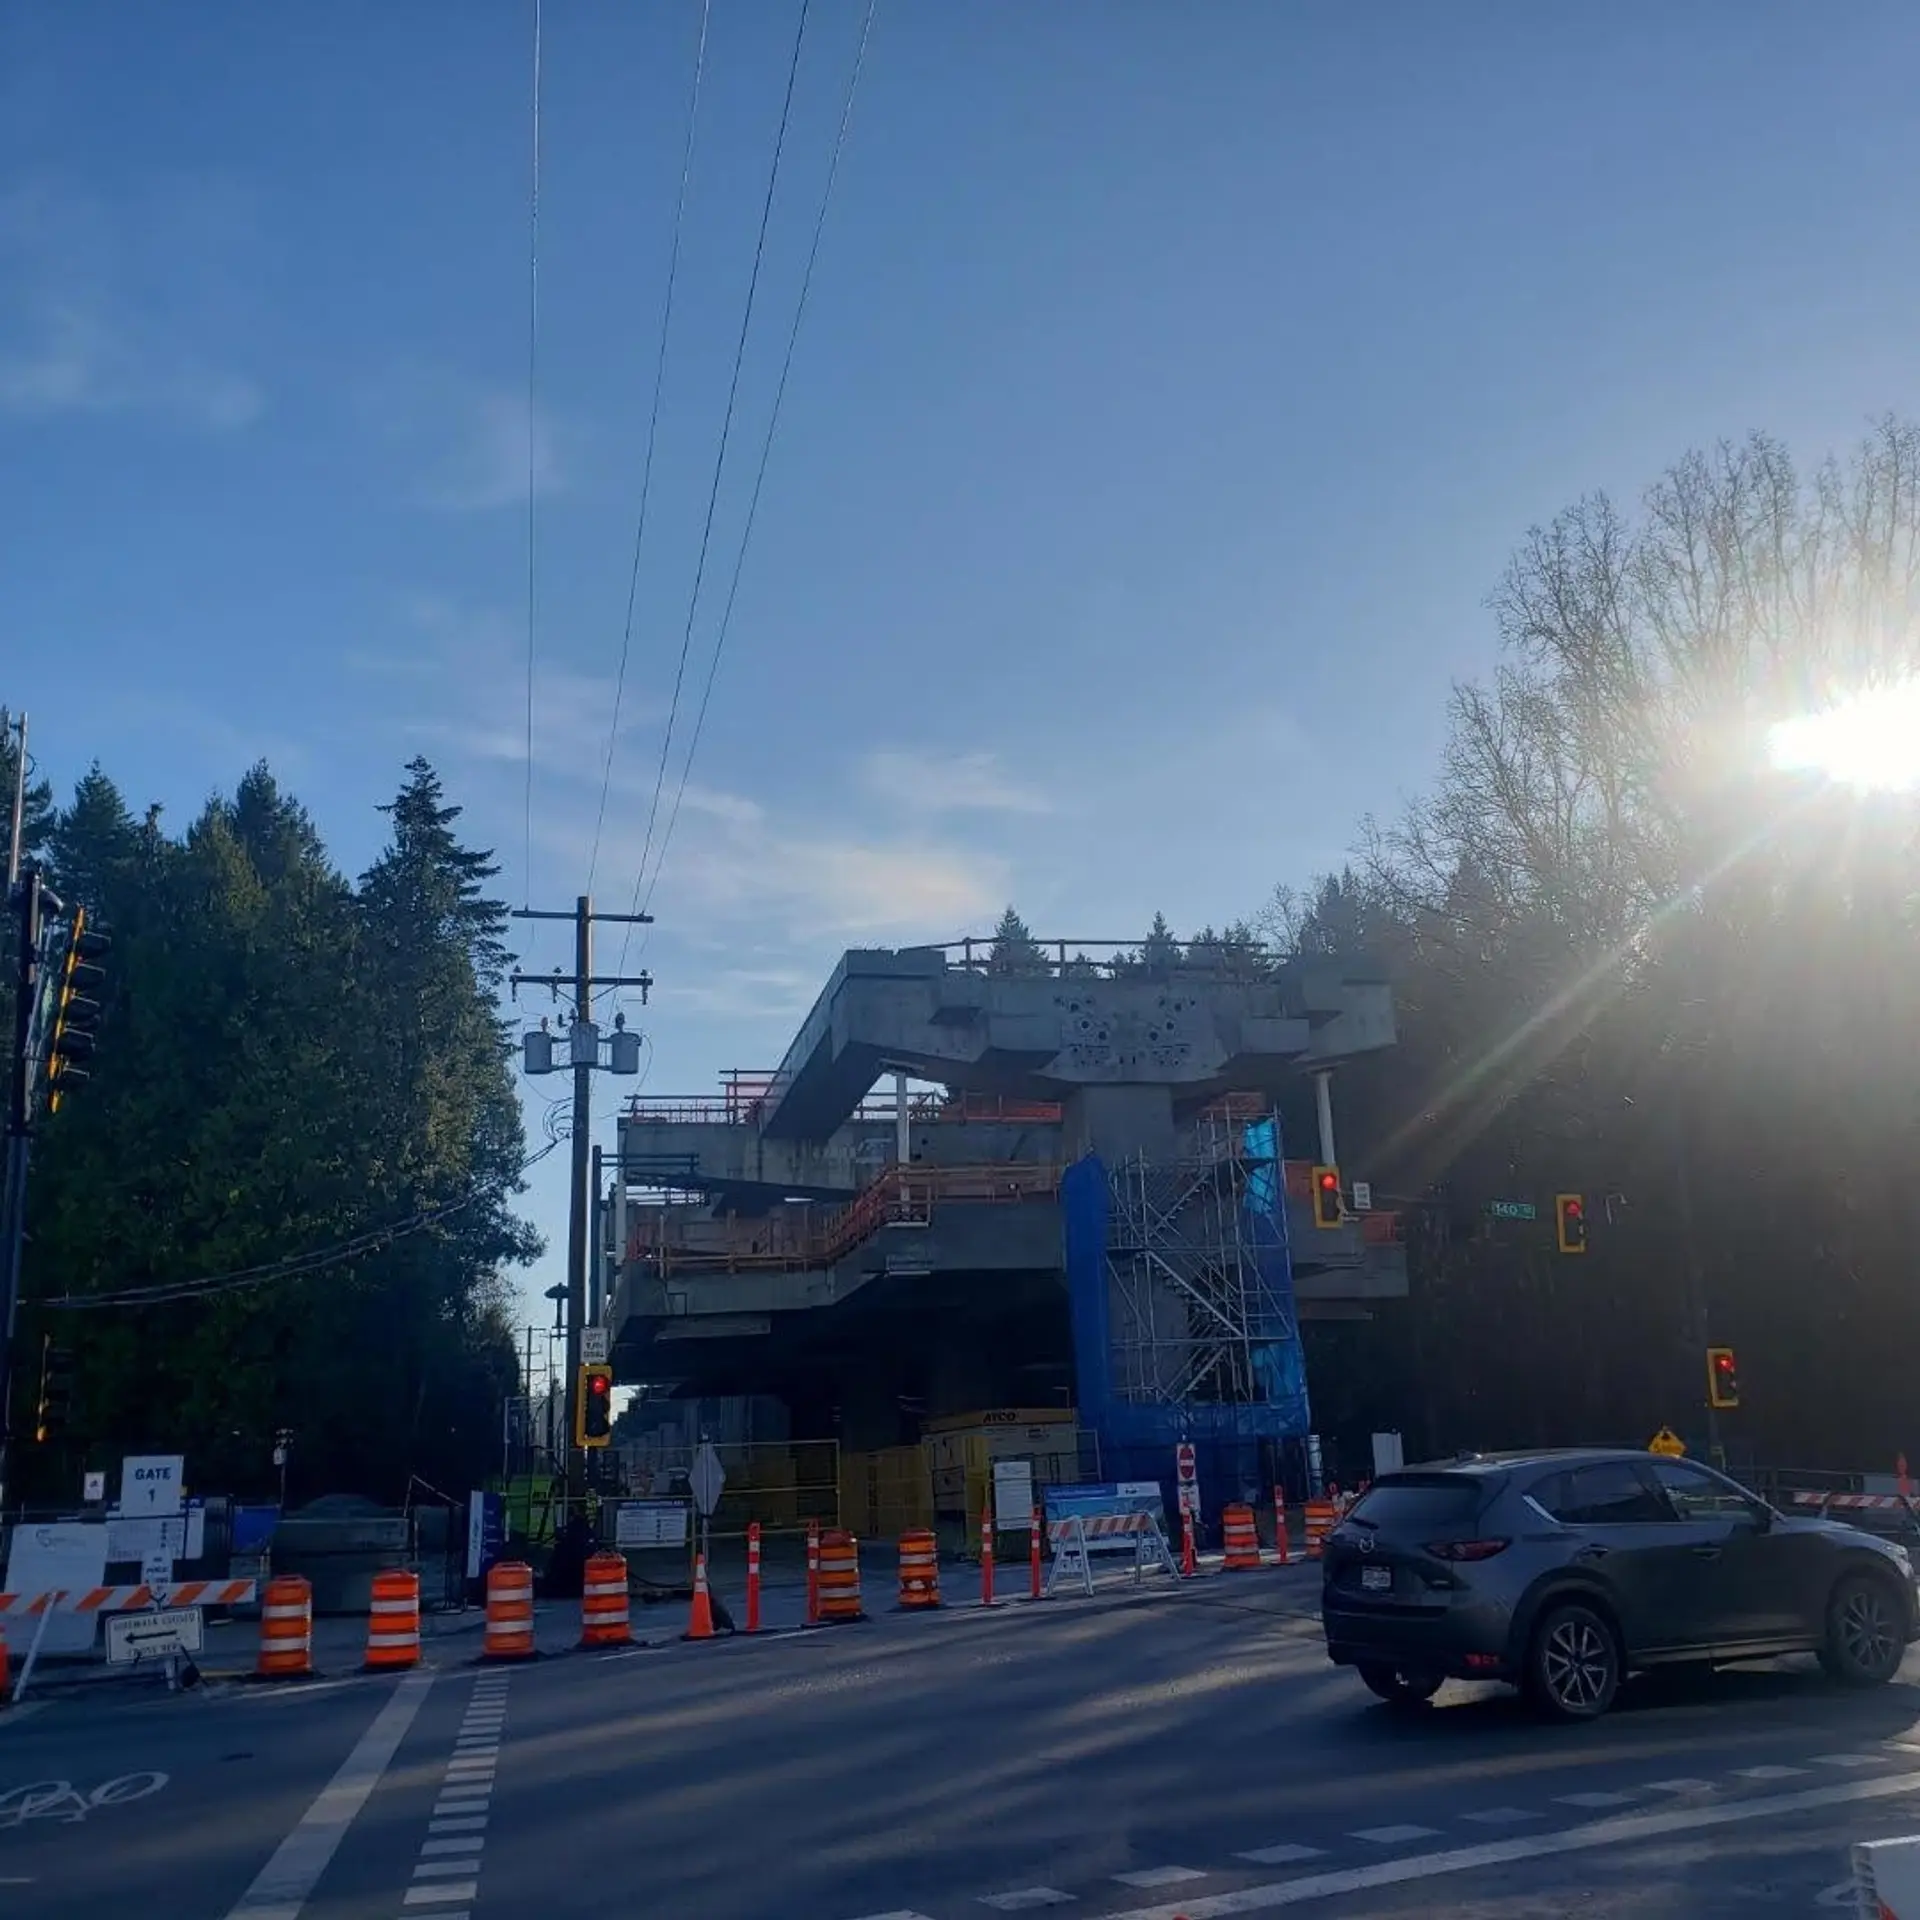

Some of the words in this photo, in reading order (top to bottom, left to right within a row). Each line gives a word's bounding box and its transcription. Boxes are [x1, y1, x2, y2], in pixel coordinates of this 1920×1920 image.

[983, 1411, 1016, 1423] ATCO
[135, 1467, 172, 1481] GATE
[148, 1488, 156, 1503] 1
